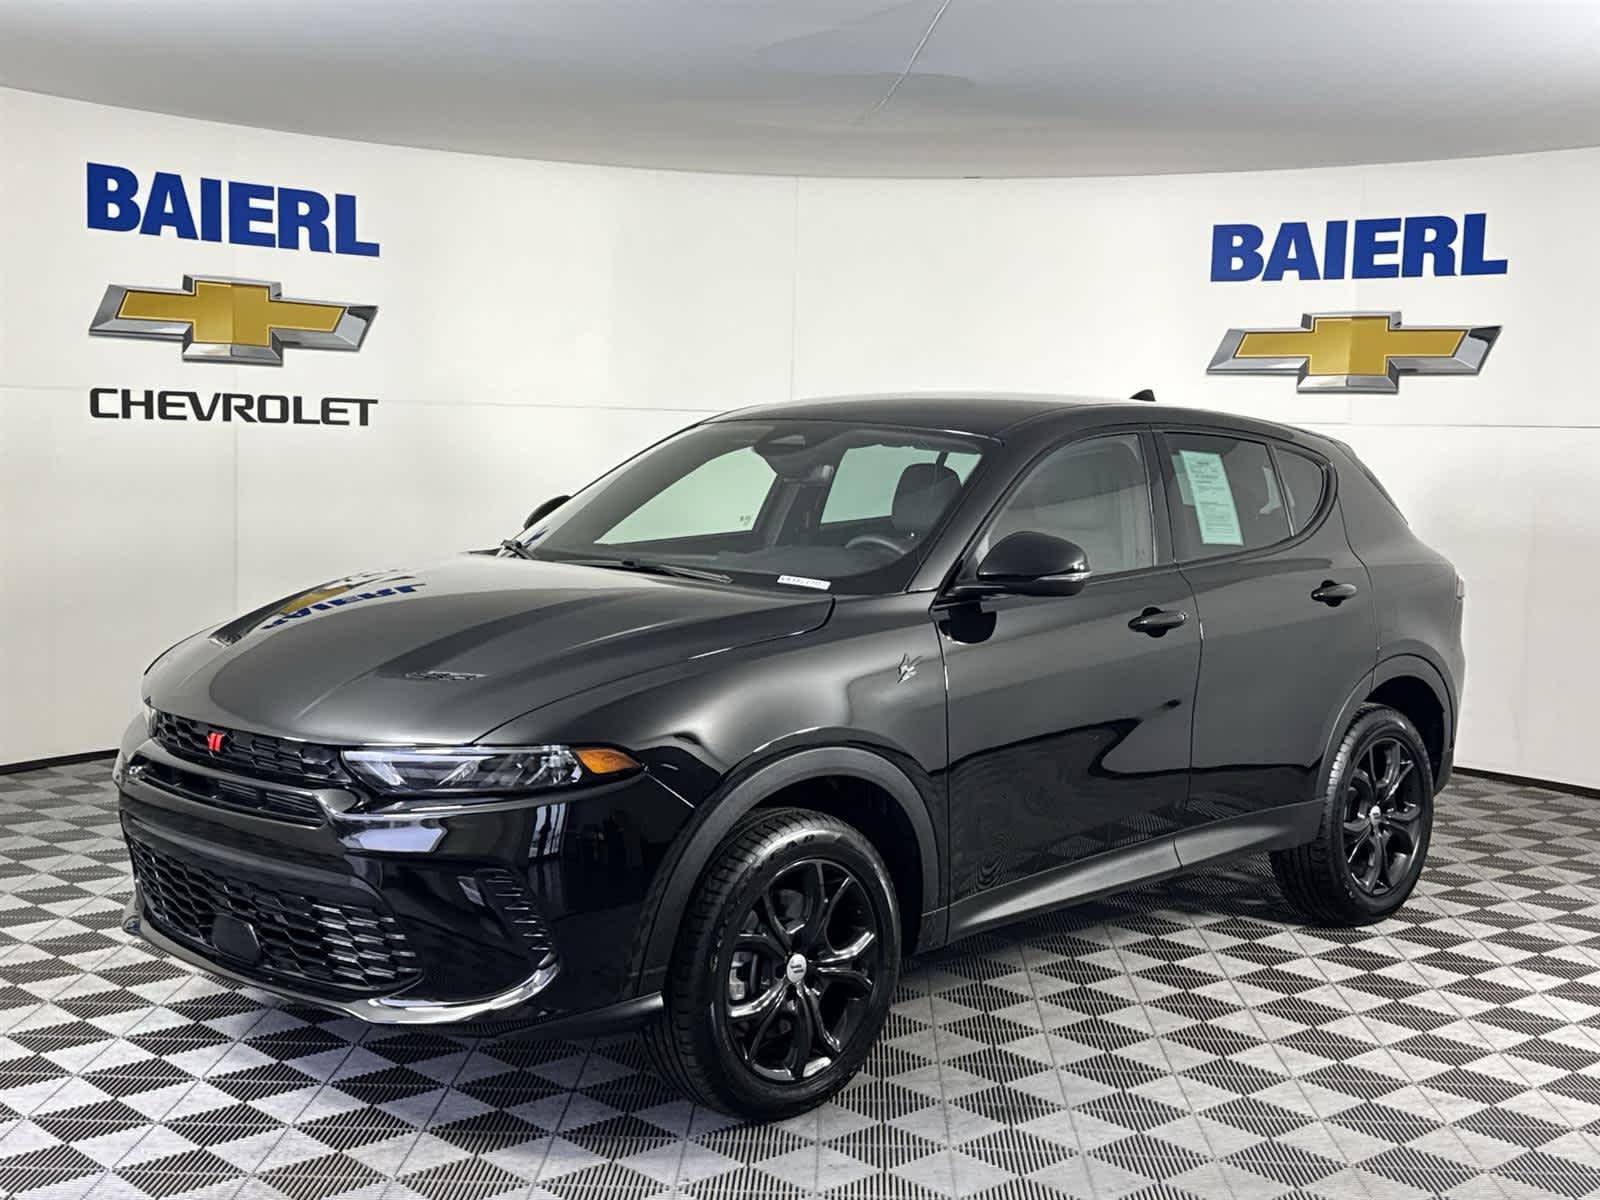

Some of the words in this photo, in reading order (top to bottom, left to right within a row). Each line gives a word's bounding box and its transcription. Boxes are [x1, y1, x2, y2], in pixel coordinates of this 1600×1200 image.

[87, 162, 380, 257] BAIERL
[1210, 213, 1508, 282] BAIERL
[90, 387, 378, 426] CHEVROLET
